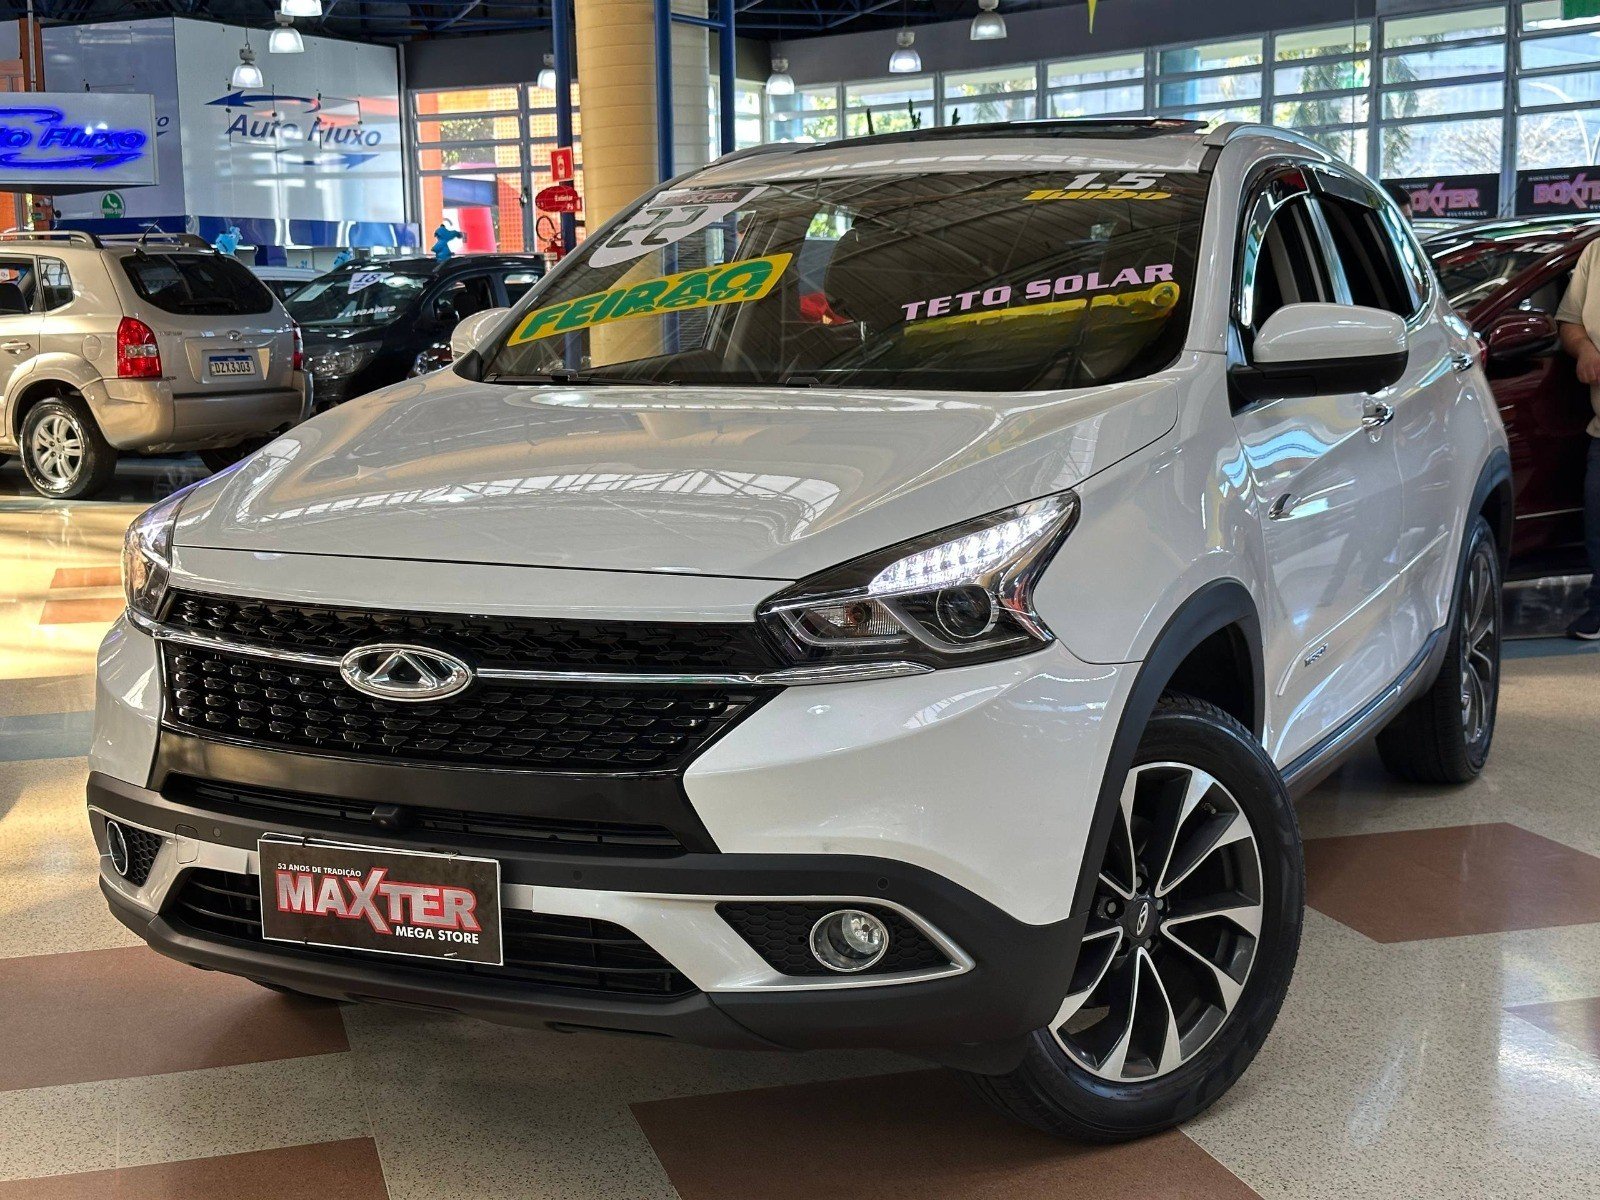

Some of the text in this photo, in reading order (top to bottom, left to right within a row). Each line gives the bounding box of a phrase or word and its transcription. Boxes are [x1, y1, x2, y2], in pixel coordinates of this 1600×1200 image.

[39, 127, 146, 150] Fluxo
[225, 114, 382, 147] Auto Fluxo
[1064, 172, 1166, 190] 1.5
[1533, 172, 1600, 209] BOXTE
[1411, 182, 1480, 216] OXTER
[605, 205, 709, 249] 22
[901, 263, 1174, 320] TETO SOLAR
[277, 862, 287, 870] 53
[288, 863, 310, 872] ANOS
[323, 867, 362, 877] TRADIÇÃO
[275, 866, 482, 935] MAXTER
[395, 925, 479, 945] MEGA STORE
